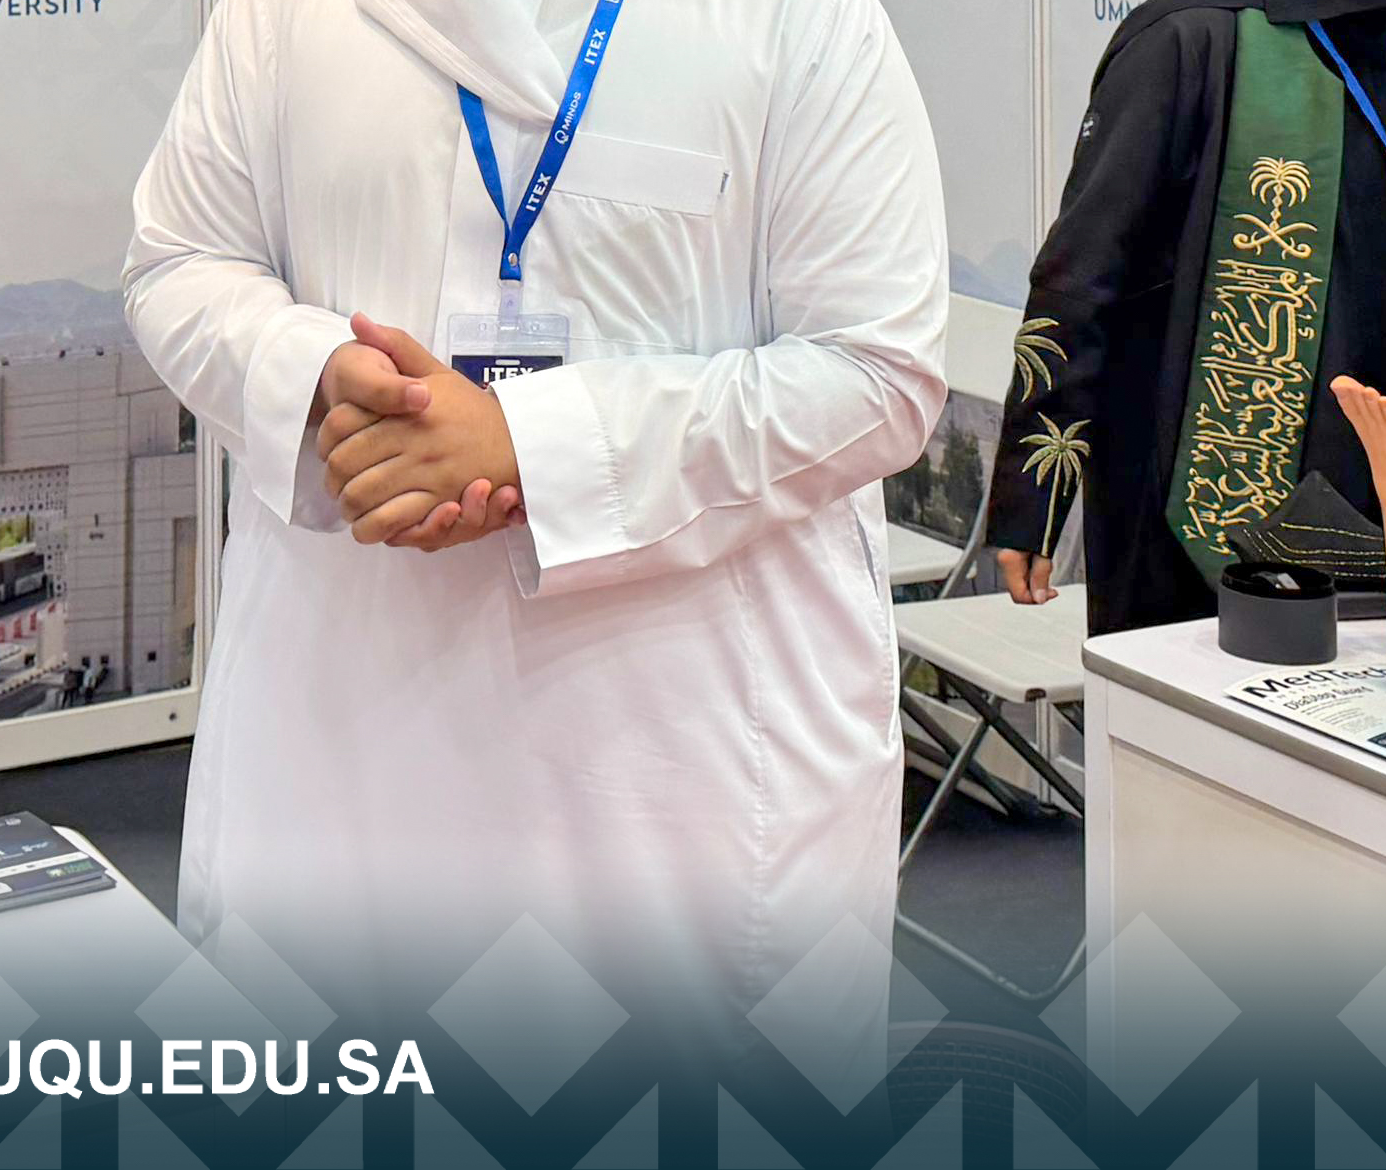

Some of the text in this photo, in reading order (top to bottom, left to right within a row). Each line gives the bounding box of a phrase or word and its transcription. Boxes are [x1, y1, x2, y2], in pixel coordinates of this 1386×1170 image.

[584, 28, 606, 65] ITEX
[564, 91, 581, 131] MINDS
[525, 172, 551, 211] ITEX
